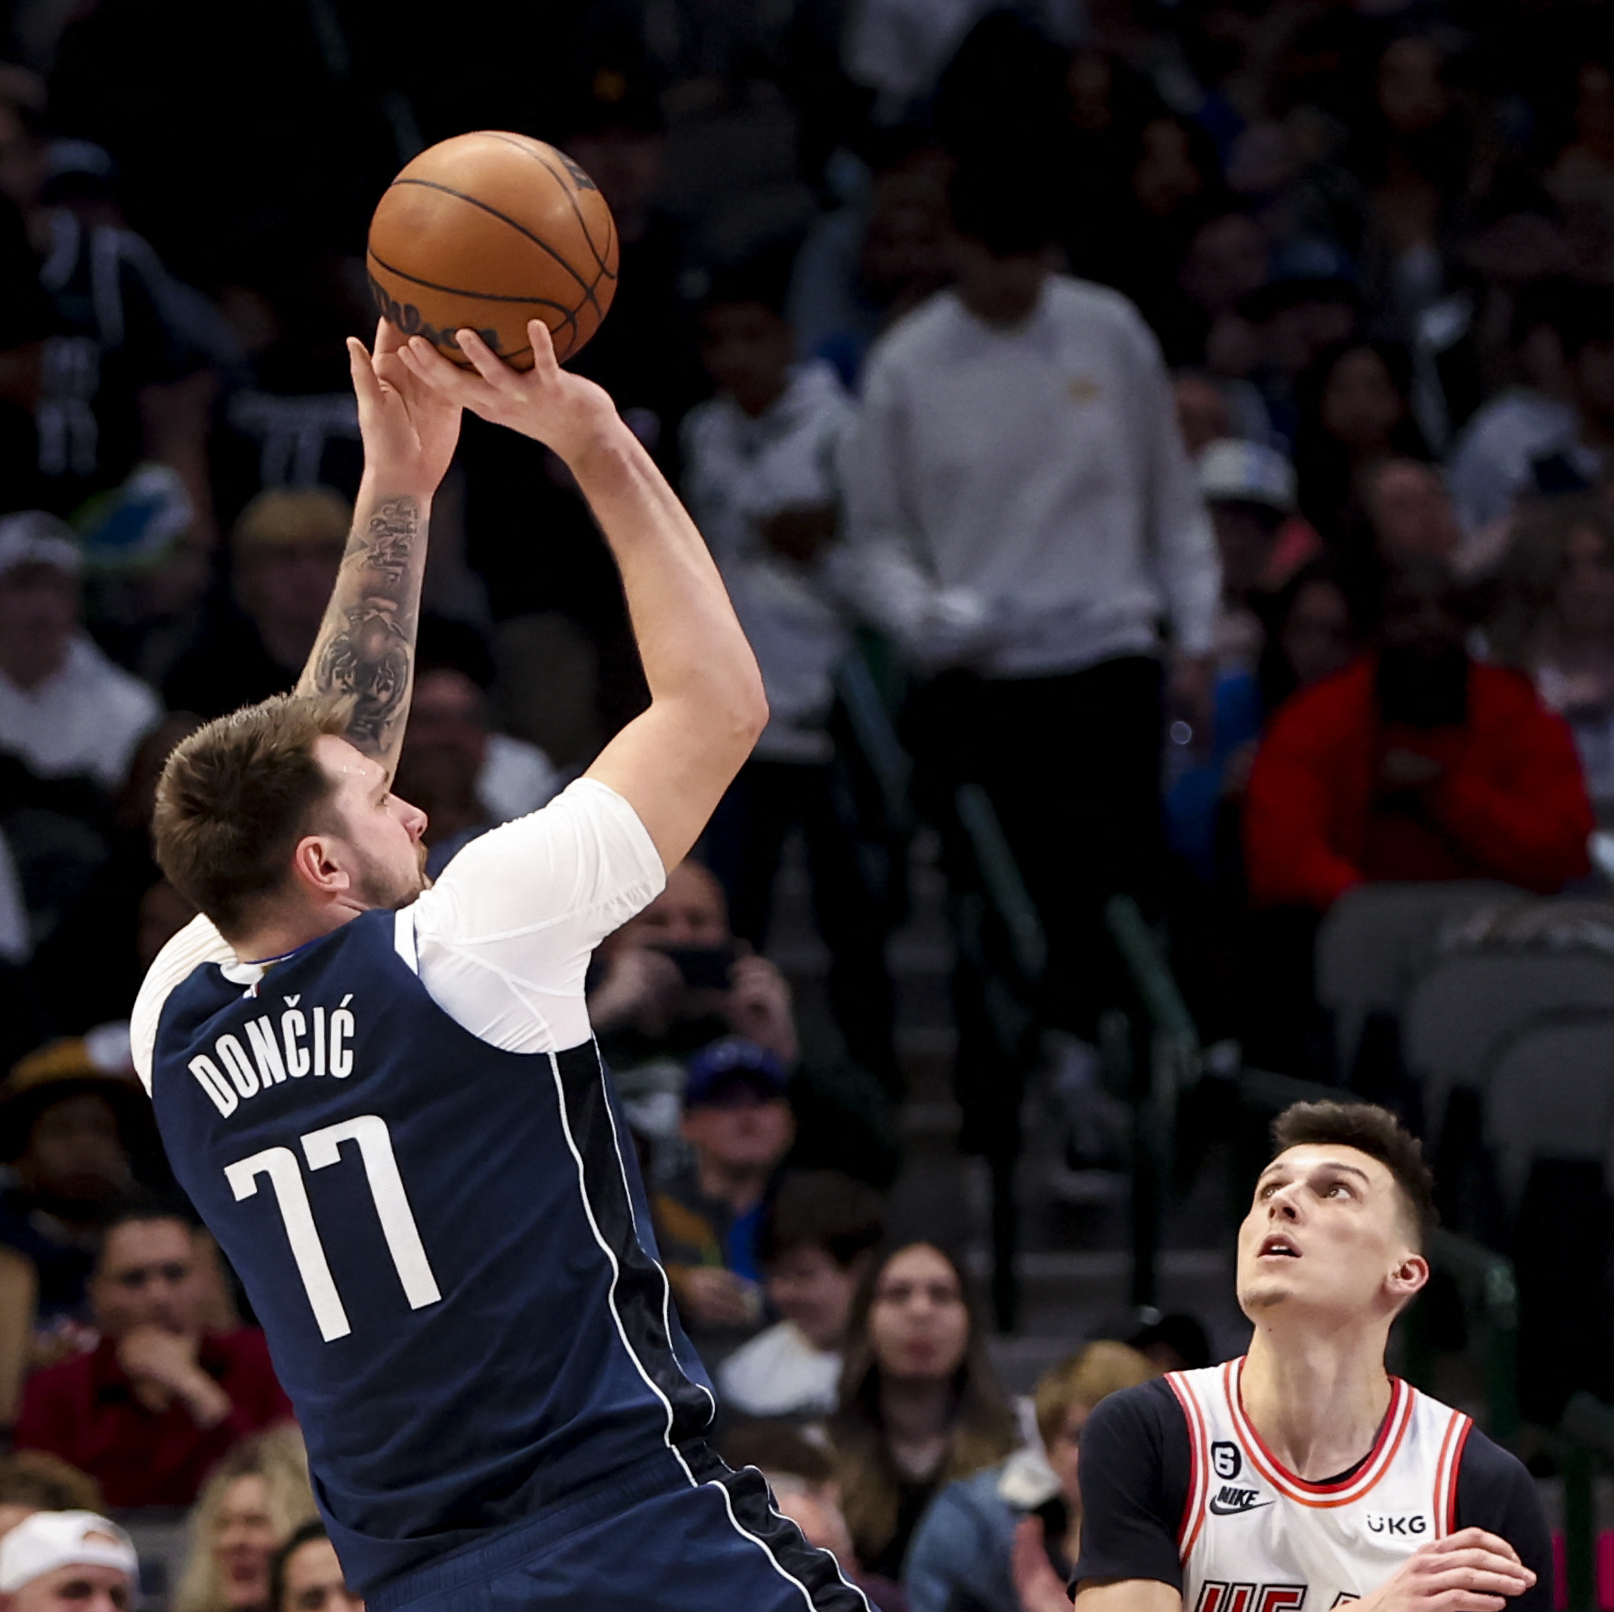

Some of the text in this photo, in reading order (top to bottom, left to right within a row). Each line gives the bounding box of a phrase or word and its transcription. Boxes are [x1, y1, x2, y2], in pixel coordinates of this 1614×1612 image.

[188, 993, 356, 1119] DONČIĆ
[223, 1113, 442, 1344] 77
[1217, 1485, 1260, 1507] NIKE
